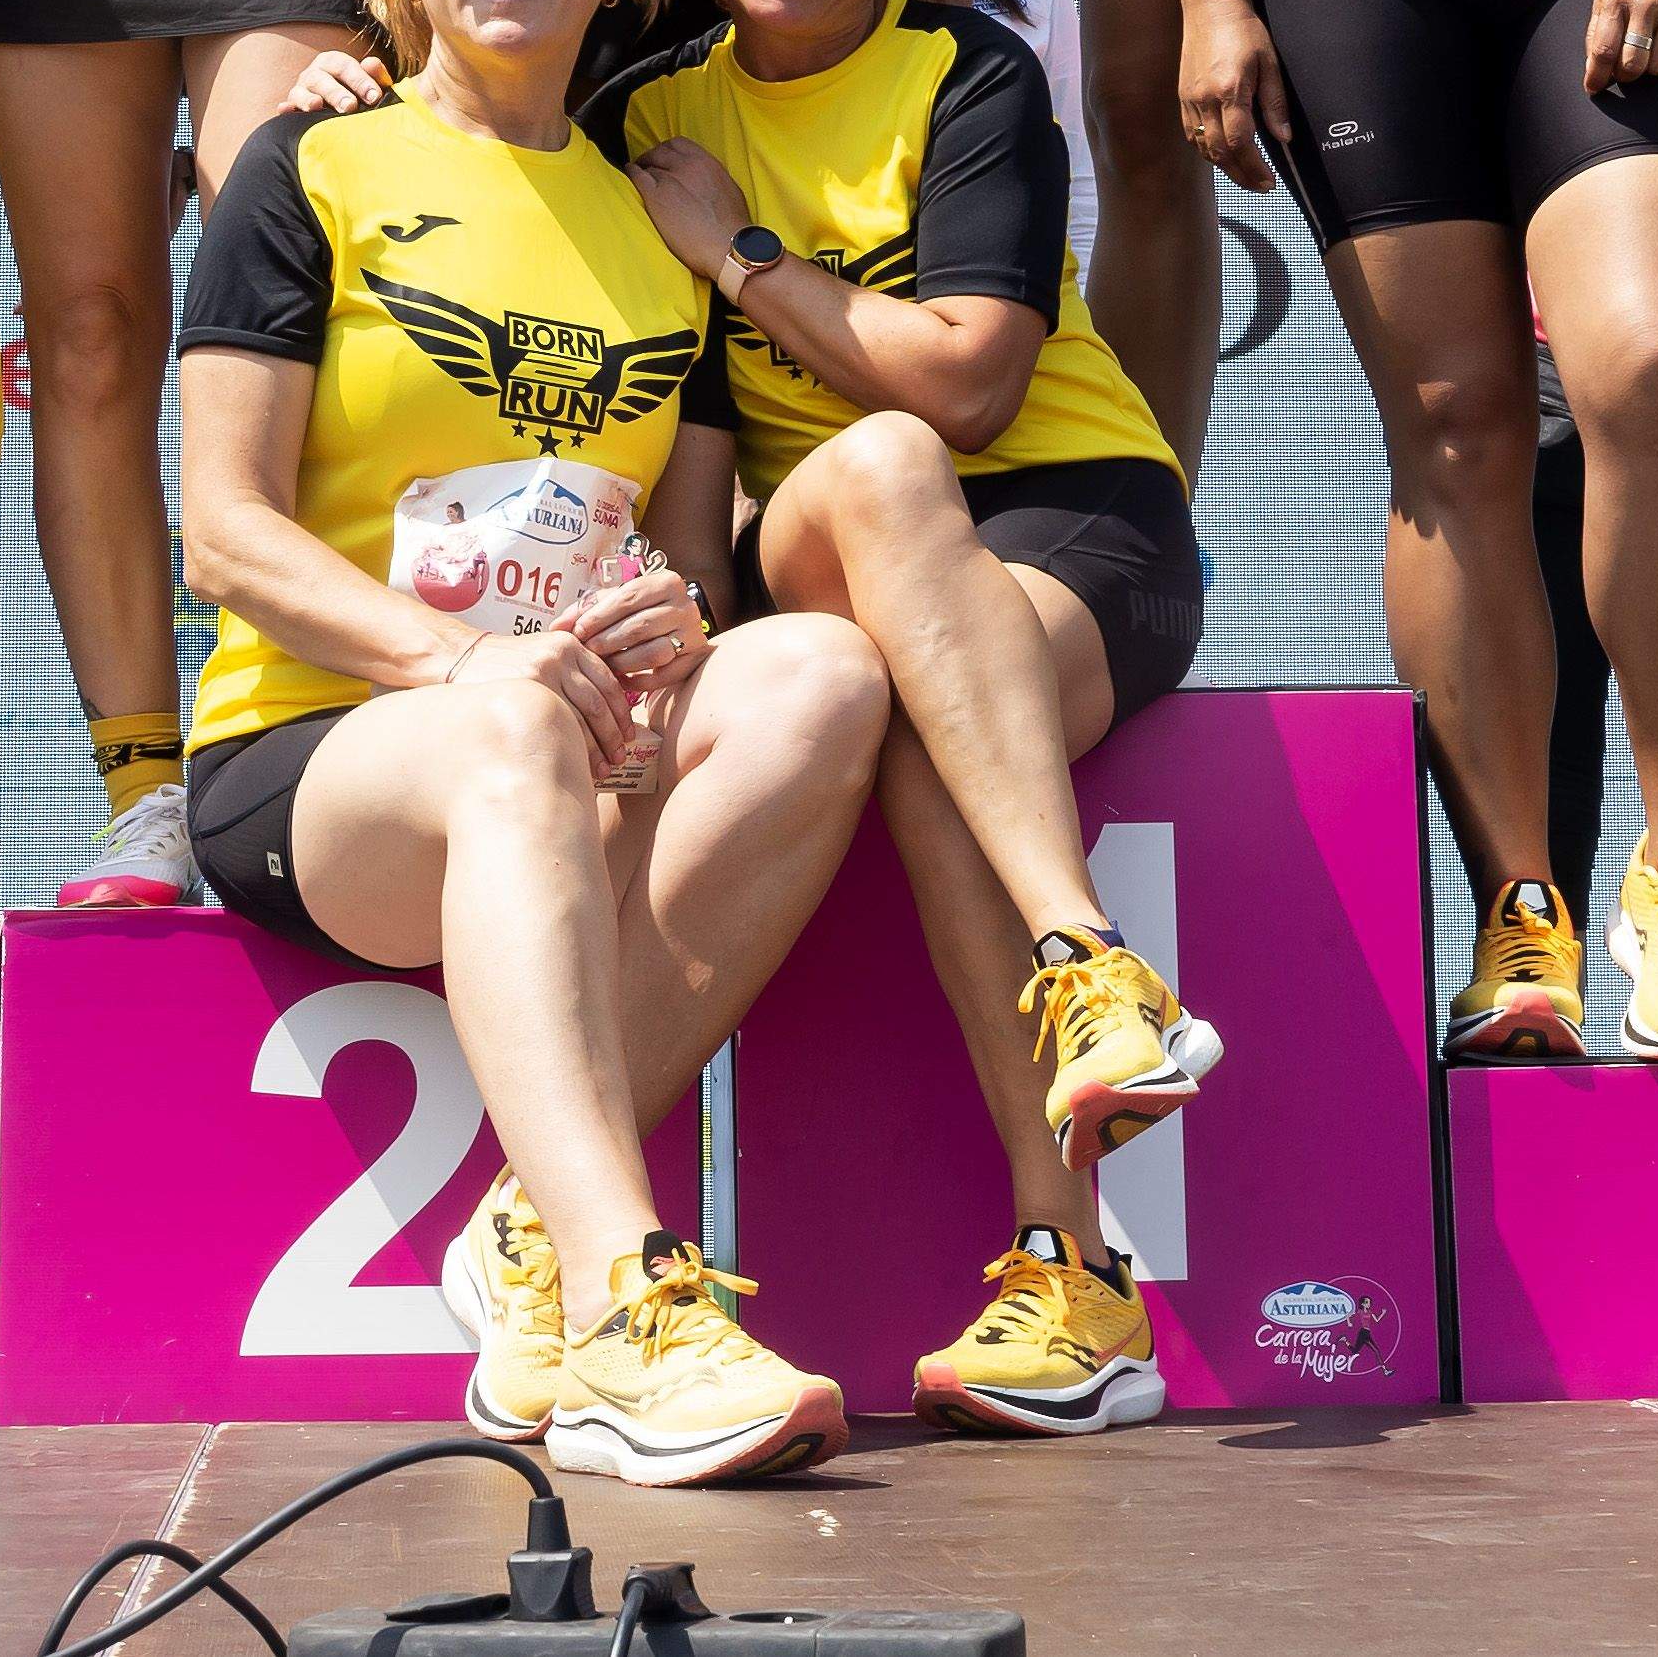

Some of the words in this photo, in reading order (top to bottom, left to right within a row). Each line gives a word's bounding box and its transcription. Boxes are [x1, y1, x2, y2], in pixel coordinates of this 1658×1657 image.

[512, 319, 599, 360] BORN
[509, 383, 601, 427] RUN
[593, 509, 619, 529] SUMA
[497, 559, 563, 608] 016
[1085, 820, 1189, 1281] 1
[240, 981, 486, 1357] 2
[1270, 1299, 1347, 1316] ASTURIANA
[1255, 1324, 1331, 1348] Carrera
[1274, 1349, 1289, 1365] de
[1292, 1347, 1302, 1364] la
[1300, 1344, 1360, 1382] Mujer
